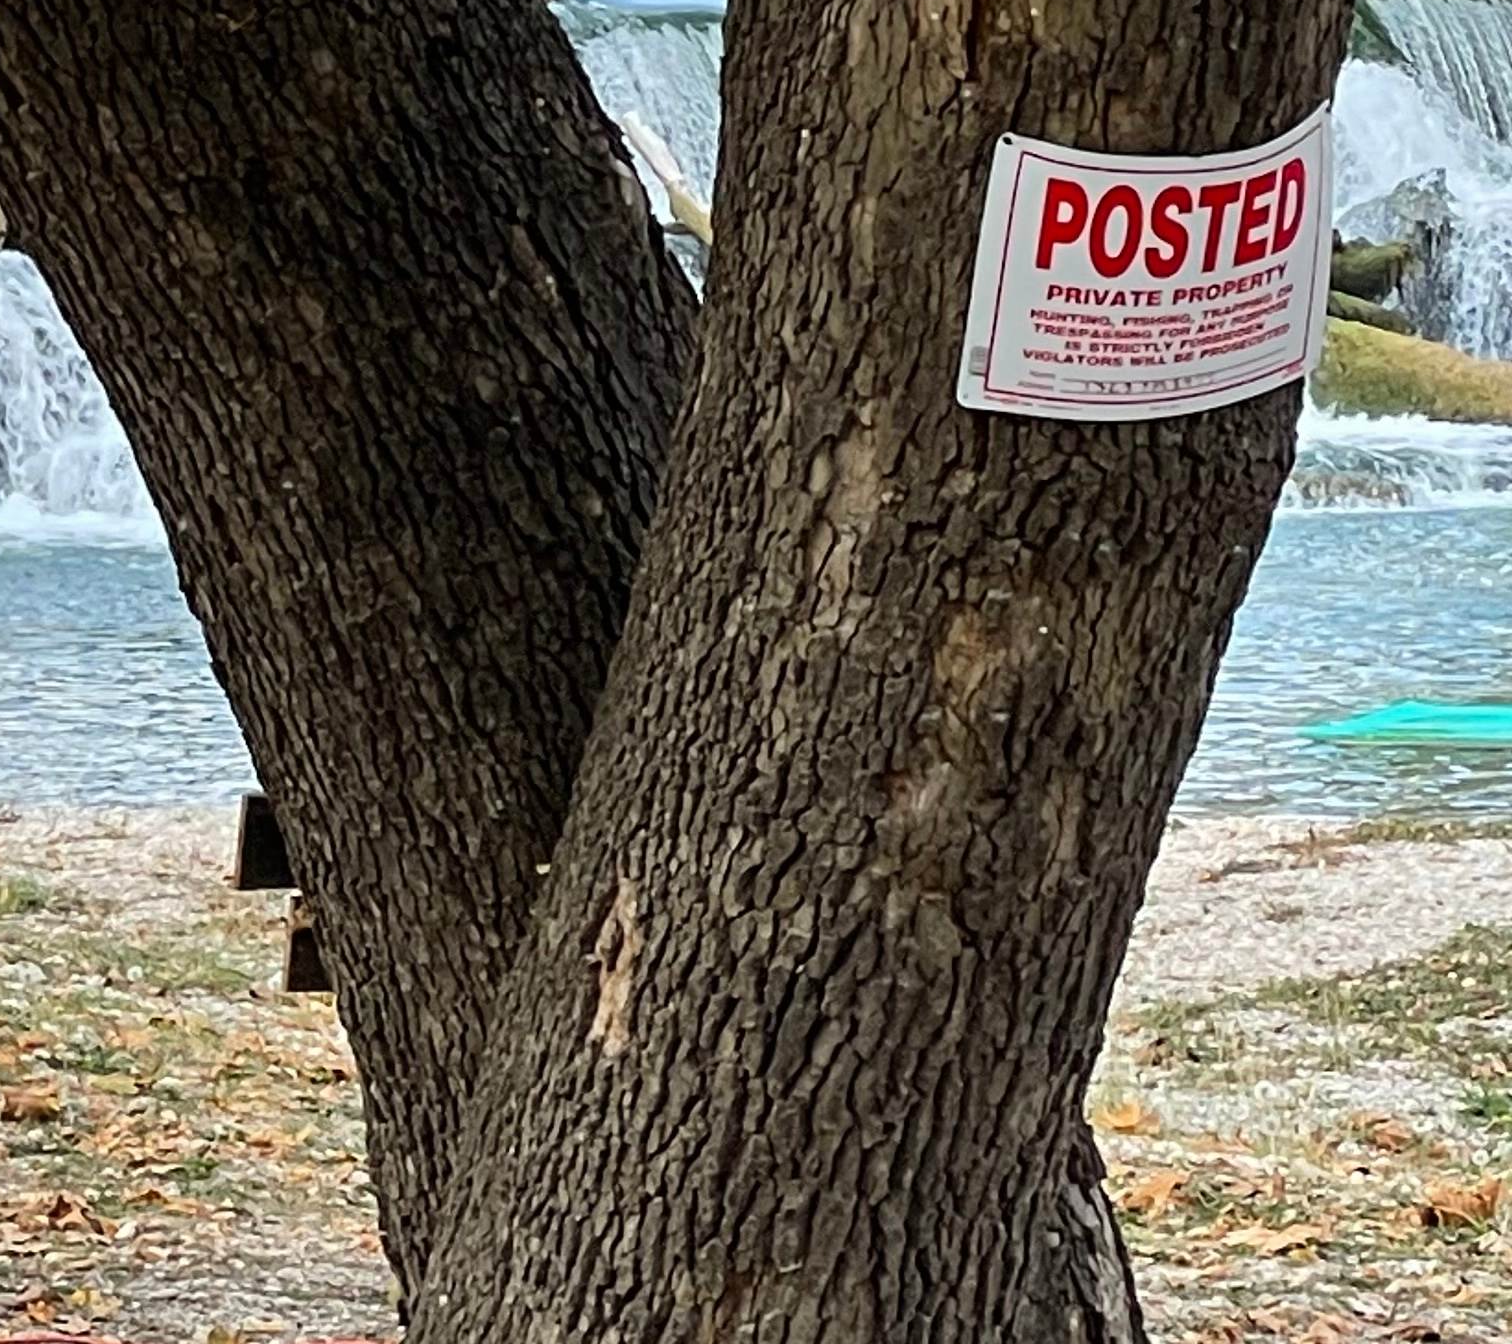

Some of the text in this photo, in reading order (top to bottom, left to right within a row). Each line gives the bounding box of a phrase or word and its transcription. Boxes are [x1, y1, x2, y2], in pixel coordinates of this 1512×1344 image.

[1035, 157, 1306, 278] POSTED
[1046, 262, 1288, 307] PRIVATE PROPERTY
[1030, 309, 1115, 328] HUNTING,
[1034, 323, 1153, 339] TRESPASSING
[1159, 326, 1191, 339] FOR
[1196, 319, 1226, 335] ANY
[1064, 341, 1081, 351] IS
[1089, 341, 1174, 353] STRICTLY
[1023, 349, 1123, 367] VIOLATORS
[1130, 355, 1167, 367] WILL
[1174, 351, 1194, 363] BE
